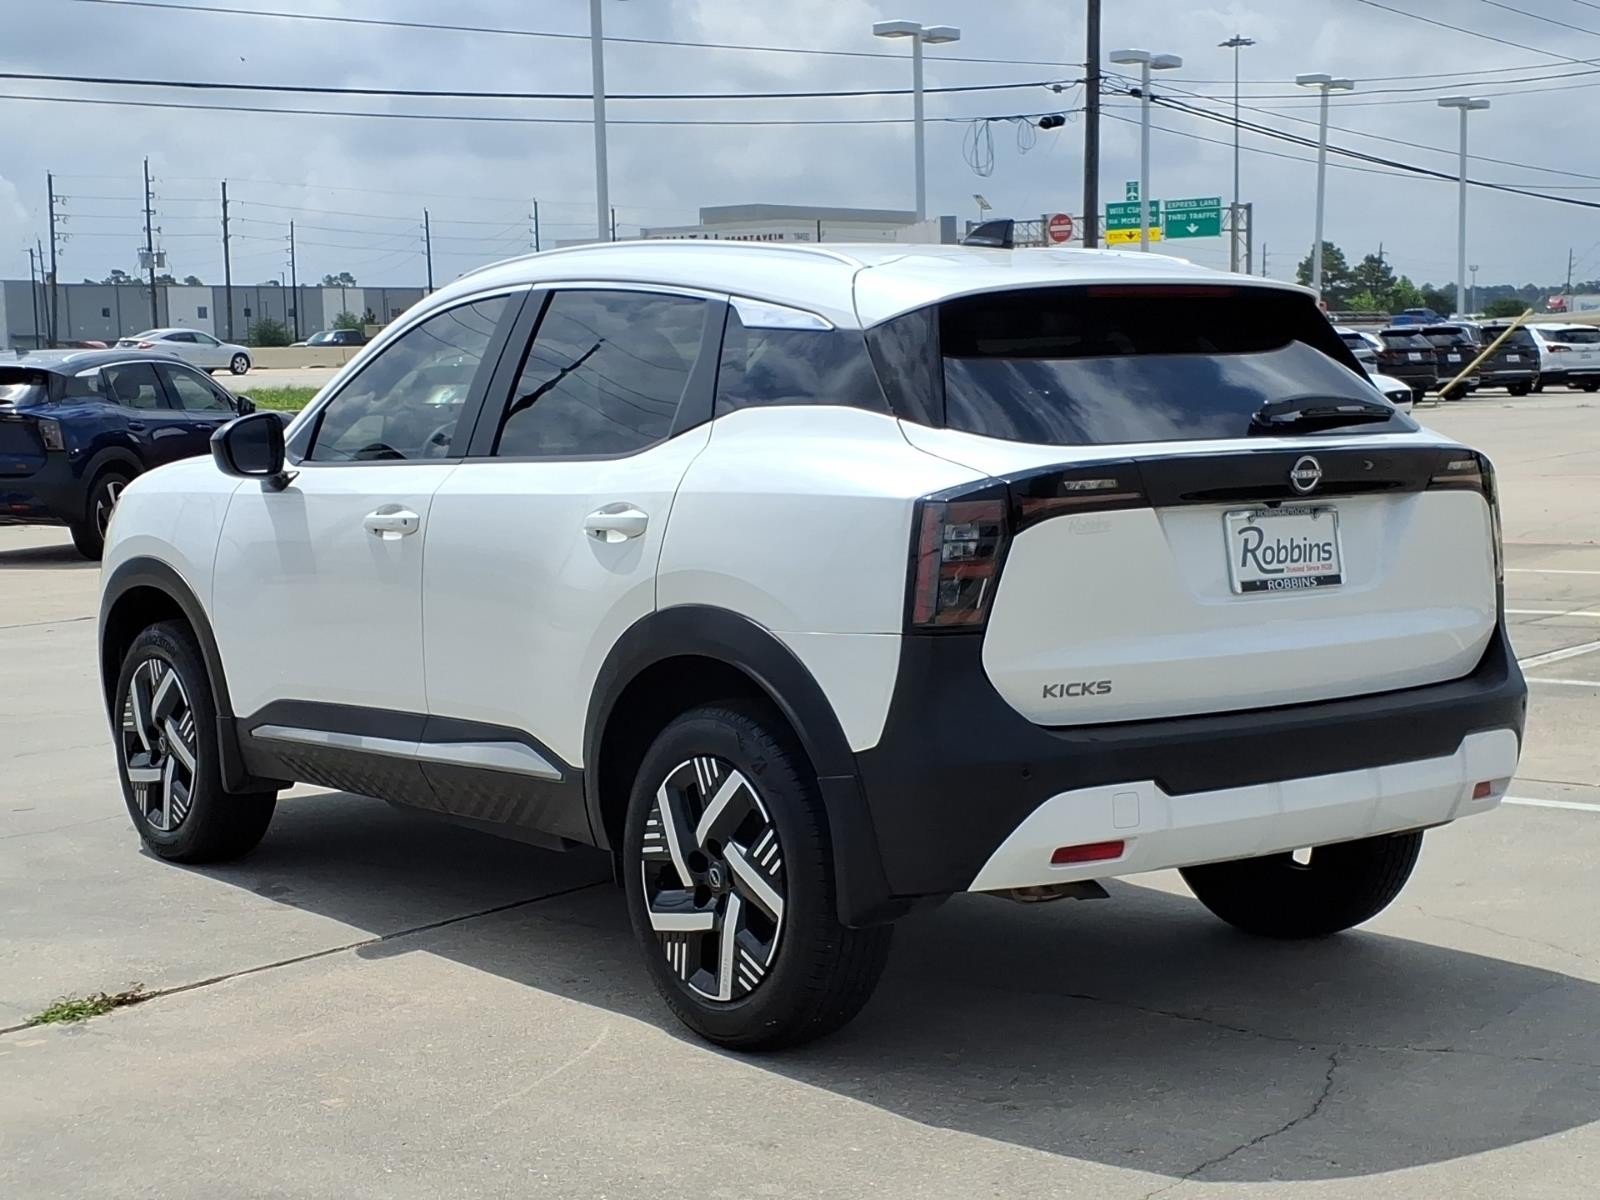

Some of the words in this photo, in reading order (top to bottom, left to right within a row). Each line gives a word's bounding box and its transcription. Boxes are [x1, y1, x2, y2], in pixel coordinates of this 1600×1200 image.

[1167, 200, 1197, 209] EXPRESS
[1199, 199, 1218, 207] LANE
[1109, 206, 1124, 215] Will
[1167, 213, 1187, 221] THRU
[1238, 526, 1332, 574] Robbins
[1267, 577, 1318, 591] ROBBINS
[1043, 680, 1112, 698] KICKS
